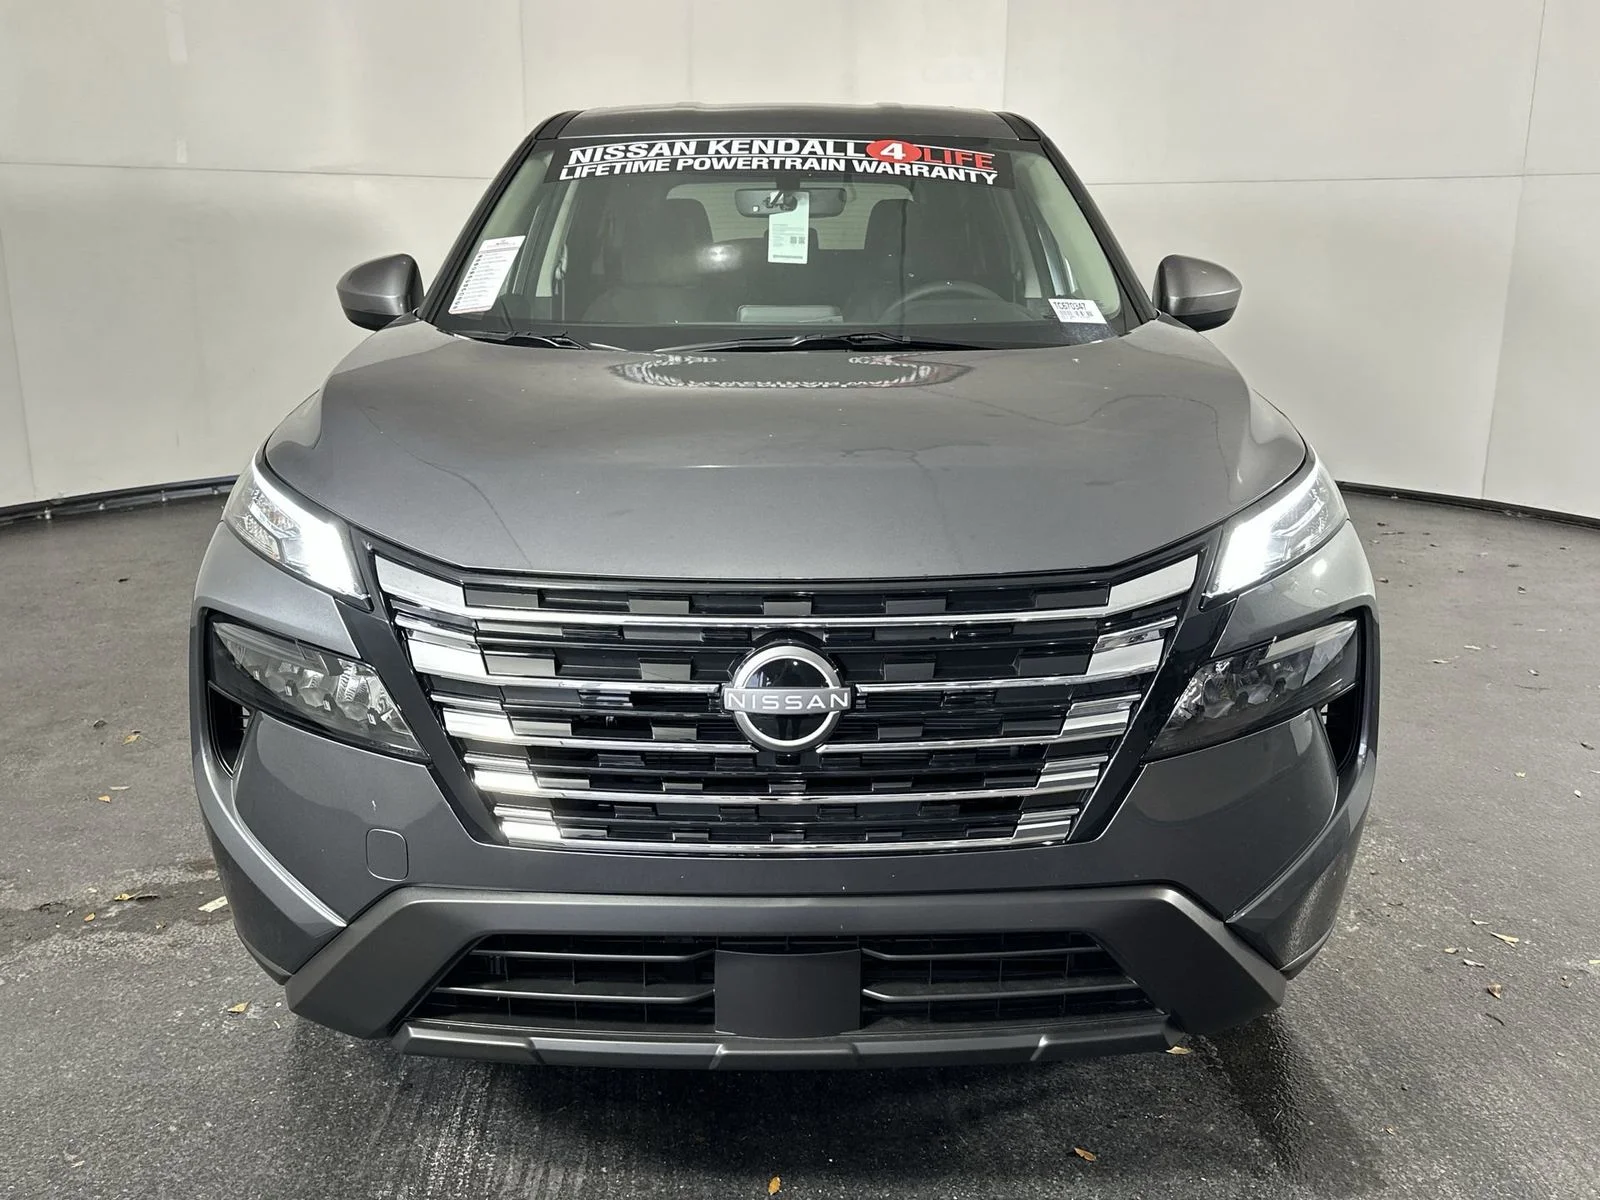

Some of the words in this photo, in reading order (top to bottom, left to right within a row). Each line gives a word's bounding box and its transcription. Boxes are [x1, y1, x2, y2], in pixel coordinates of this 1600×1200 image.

[568, 141, 697, 165] NISSAN
[707, 139, 866, 157] KENDALL
[880, 142, 906, 160] 4
[923, 148, 994, 170] LIFE
[559, 159, 671, 181] LIFETIME
[676, 157, 846, 171] POWERTRAIN
[852, 160, 998, 185] WARRANTY
[728, 692, 848, 710] NISSAN
